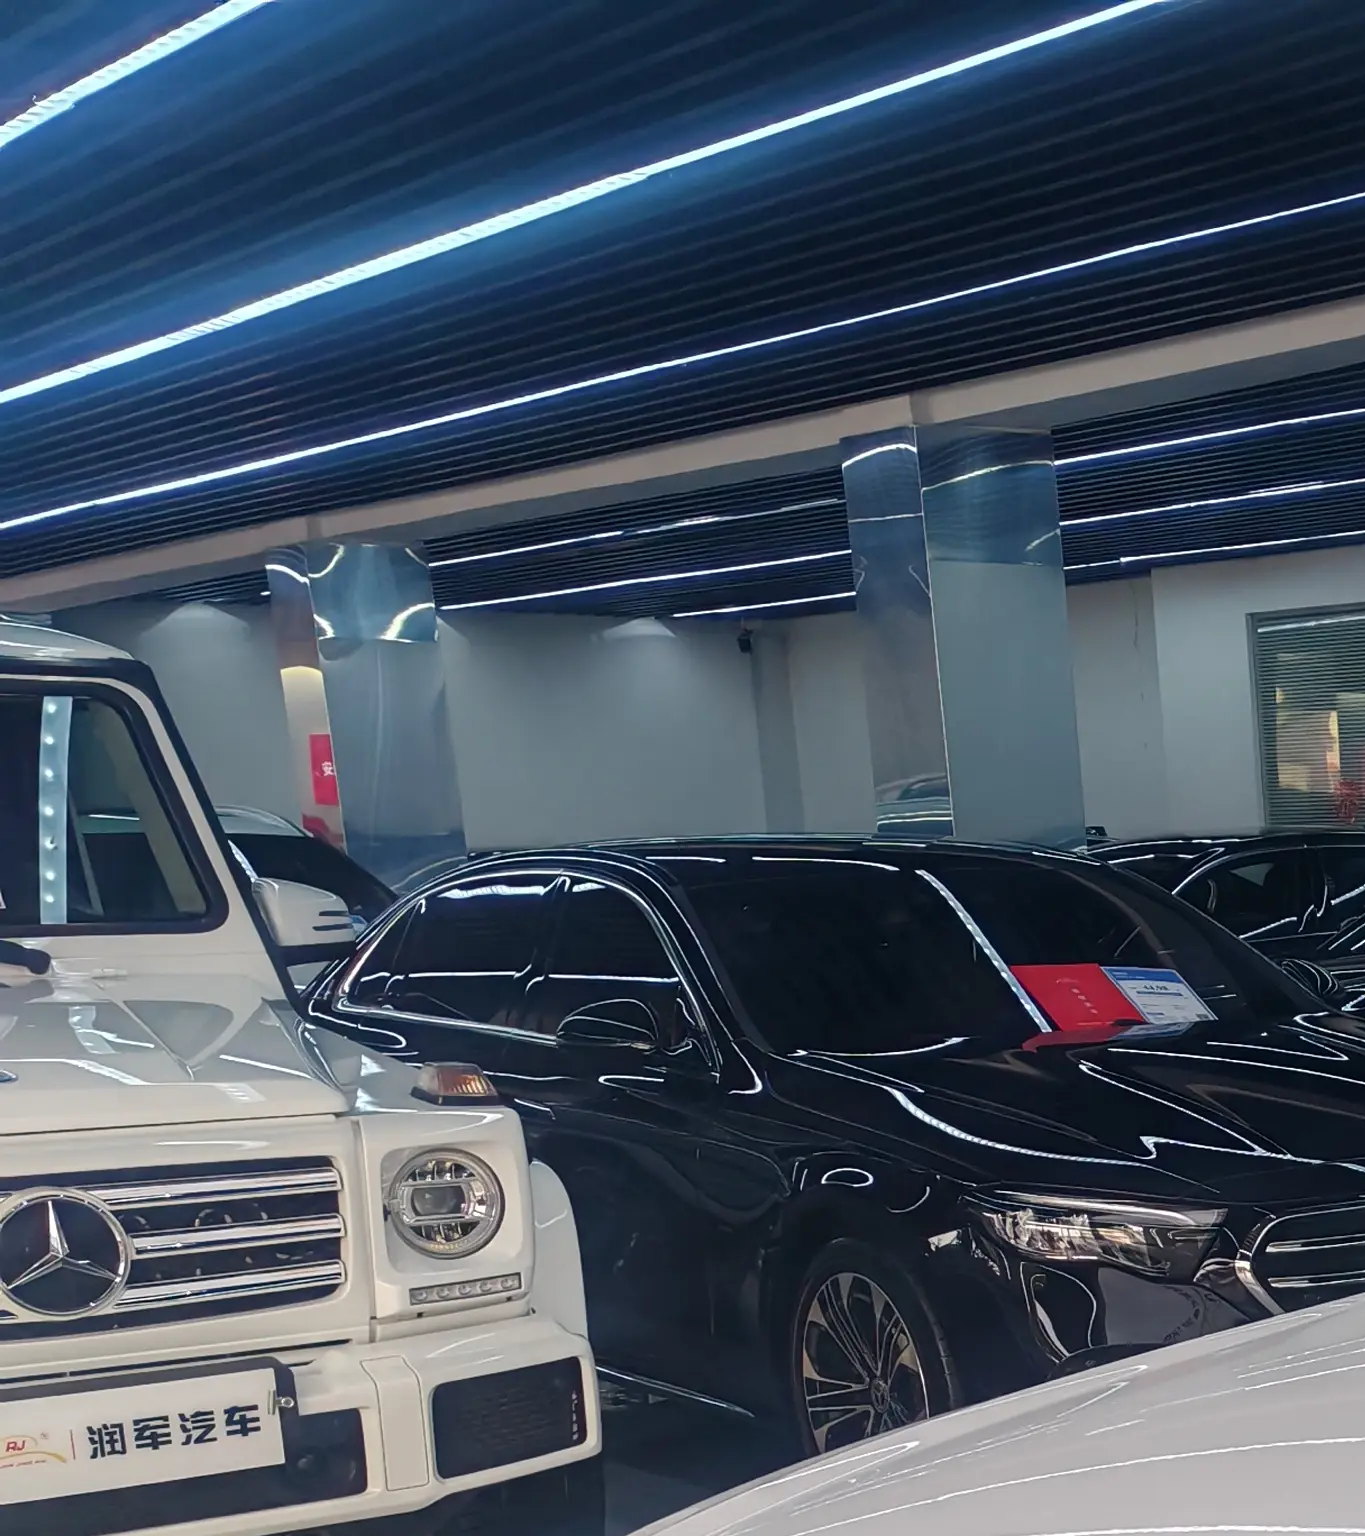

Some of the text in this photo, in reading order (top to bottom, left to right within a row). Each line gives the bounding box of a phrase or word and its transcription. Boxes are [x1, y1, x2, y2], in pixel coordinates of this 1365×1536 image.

[5, 1439, 26, 1452] RJ
[86, 1404, 262, 1460] 润军汽车
